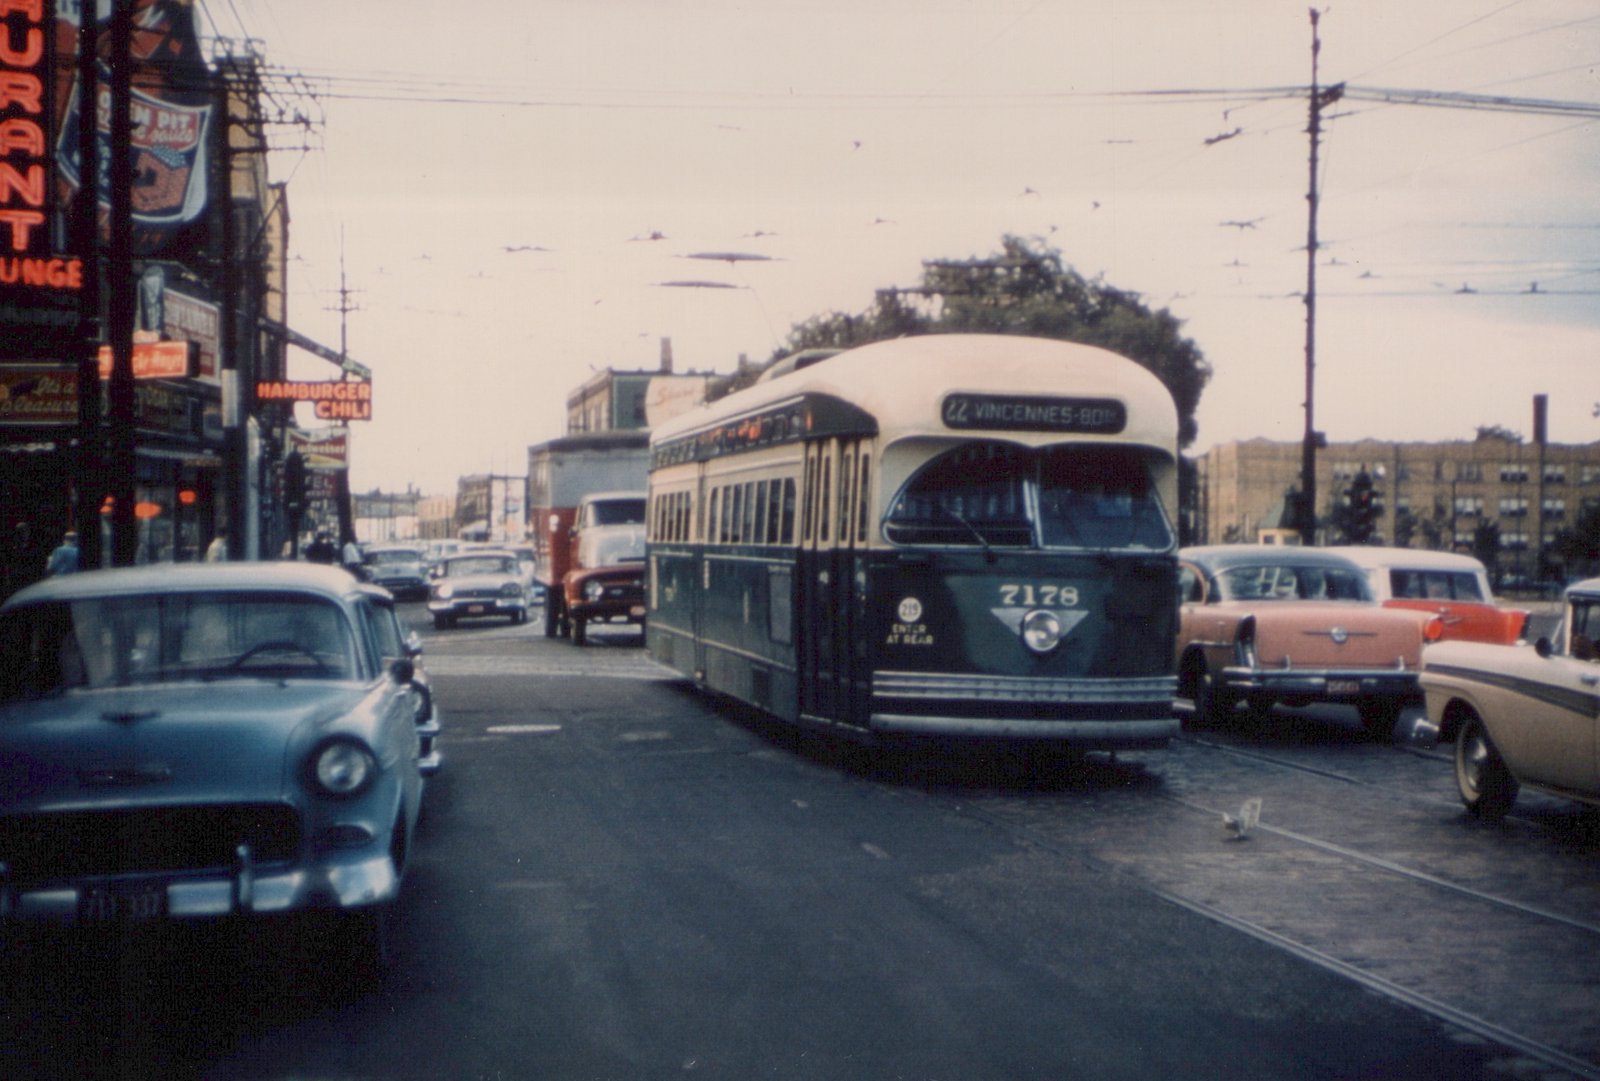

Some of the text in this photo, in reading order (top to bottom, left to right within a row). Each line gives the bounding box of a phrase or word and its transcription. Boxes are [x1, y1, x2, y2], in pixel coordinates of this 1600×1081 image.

[158, 110, 191, 129] PIT
[257, 382, 370, 400] HAMBURGER
[315, 401, 370, 418] CHILI
[946, 400, 968, 423] 22
[1000, 585, 1079, 607] 7178
[886, 634, 933, 646] AT REAR
